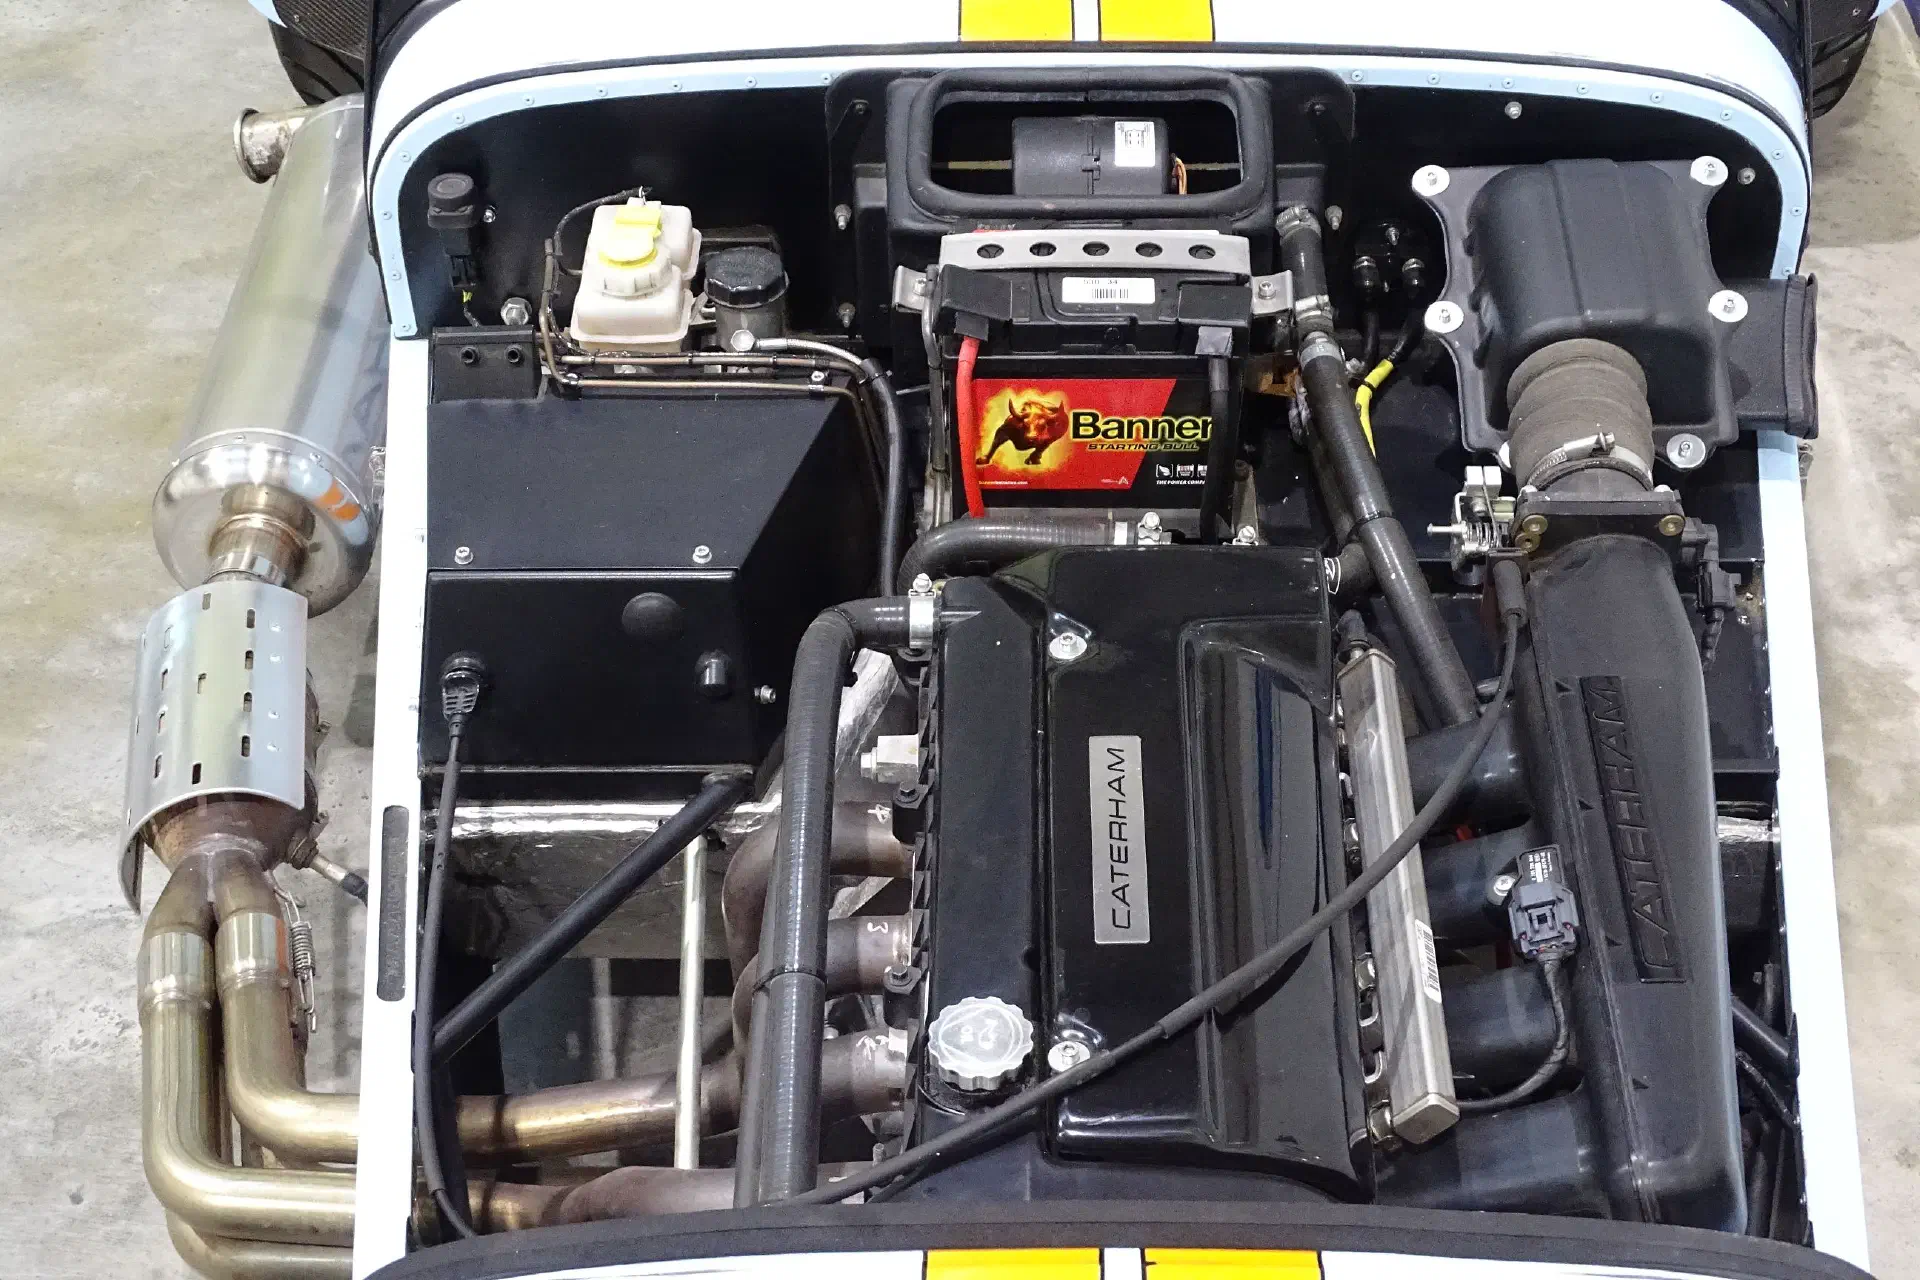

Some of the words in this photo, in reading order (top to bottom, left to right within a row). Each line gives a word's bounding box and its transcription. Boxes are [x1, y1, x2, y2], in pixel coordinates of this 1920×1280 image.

[1071, 410, 1212, 440] Banner
[1087, 442, 1159, 451] STARTING
[1160, 442, 1200, 451] BULL
[1106, 747, 1131, 929] CATERHAM
[1589, 687, 1676, 969] CATERHAM
